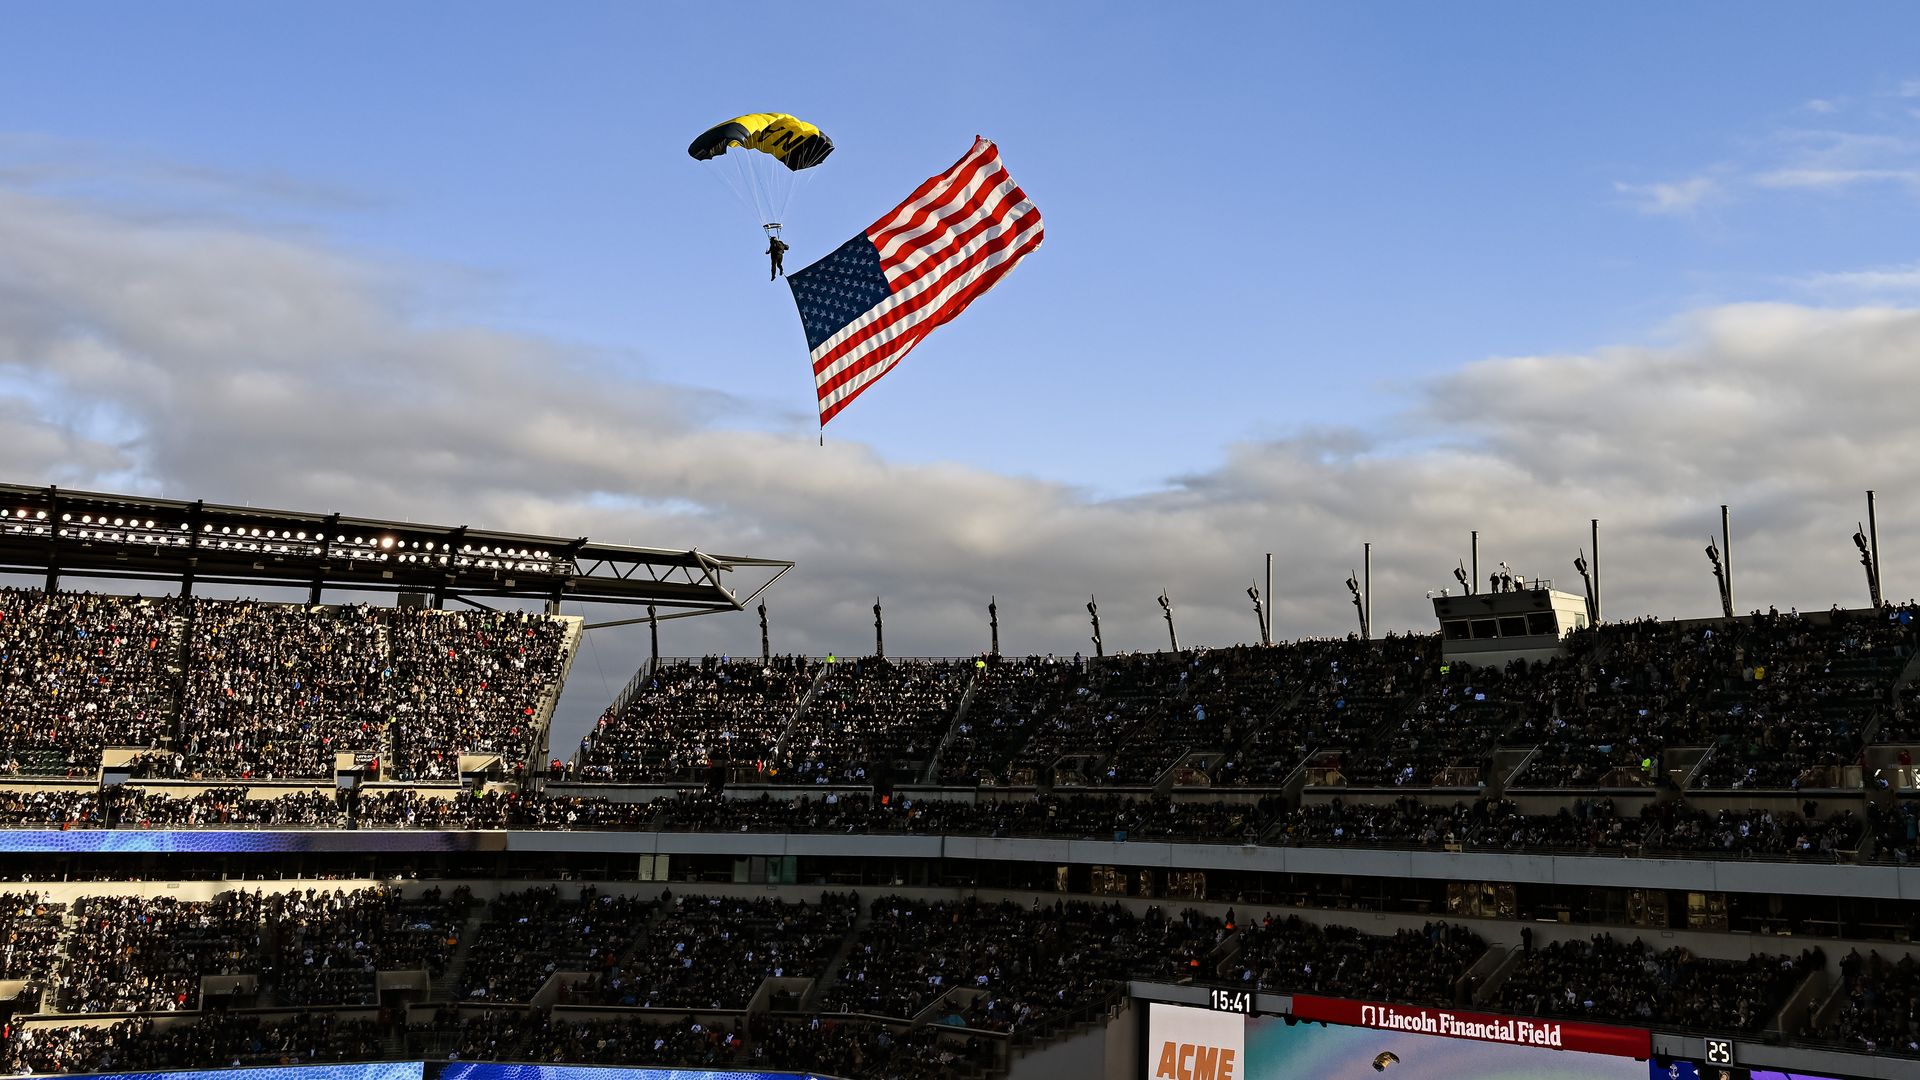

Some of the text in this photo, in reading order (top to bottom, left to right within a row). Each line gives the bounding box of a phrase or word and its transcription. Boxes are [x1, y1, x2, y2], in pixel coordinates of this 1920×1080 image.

[1211, 989, 1250, 1013] 15:41
[1378, 1007, 1562, 1047] Lincoln Financial Field
[1156, 1041, 1235, 1080] ACME
[1708, 1041, 1730, 1063] 25
